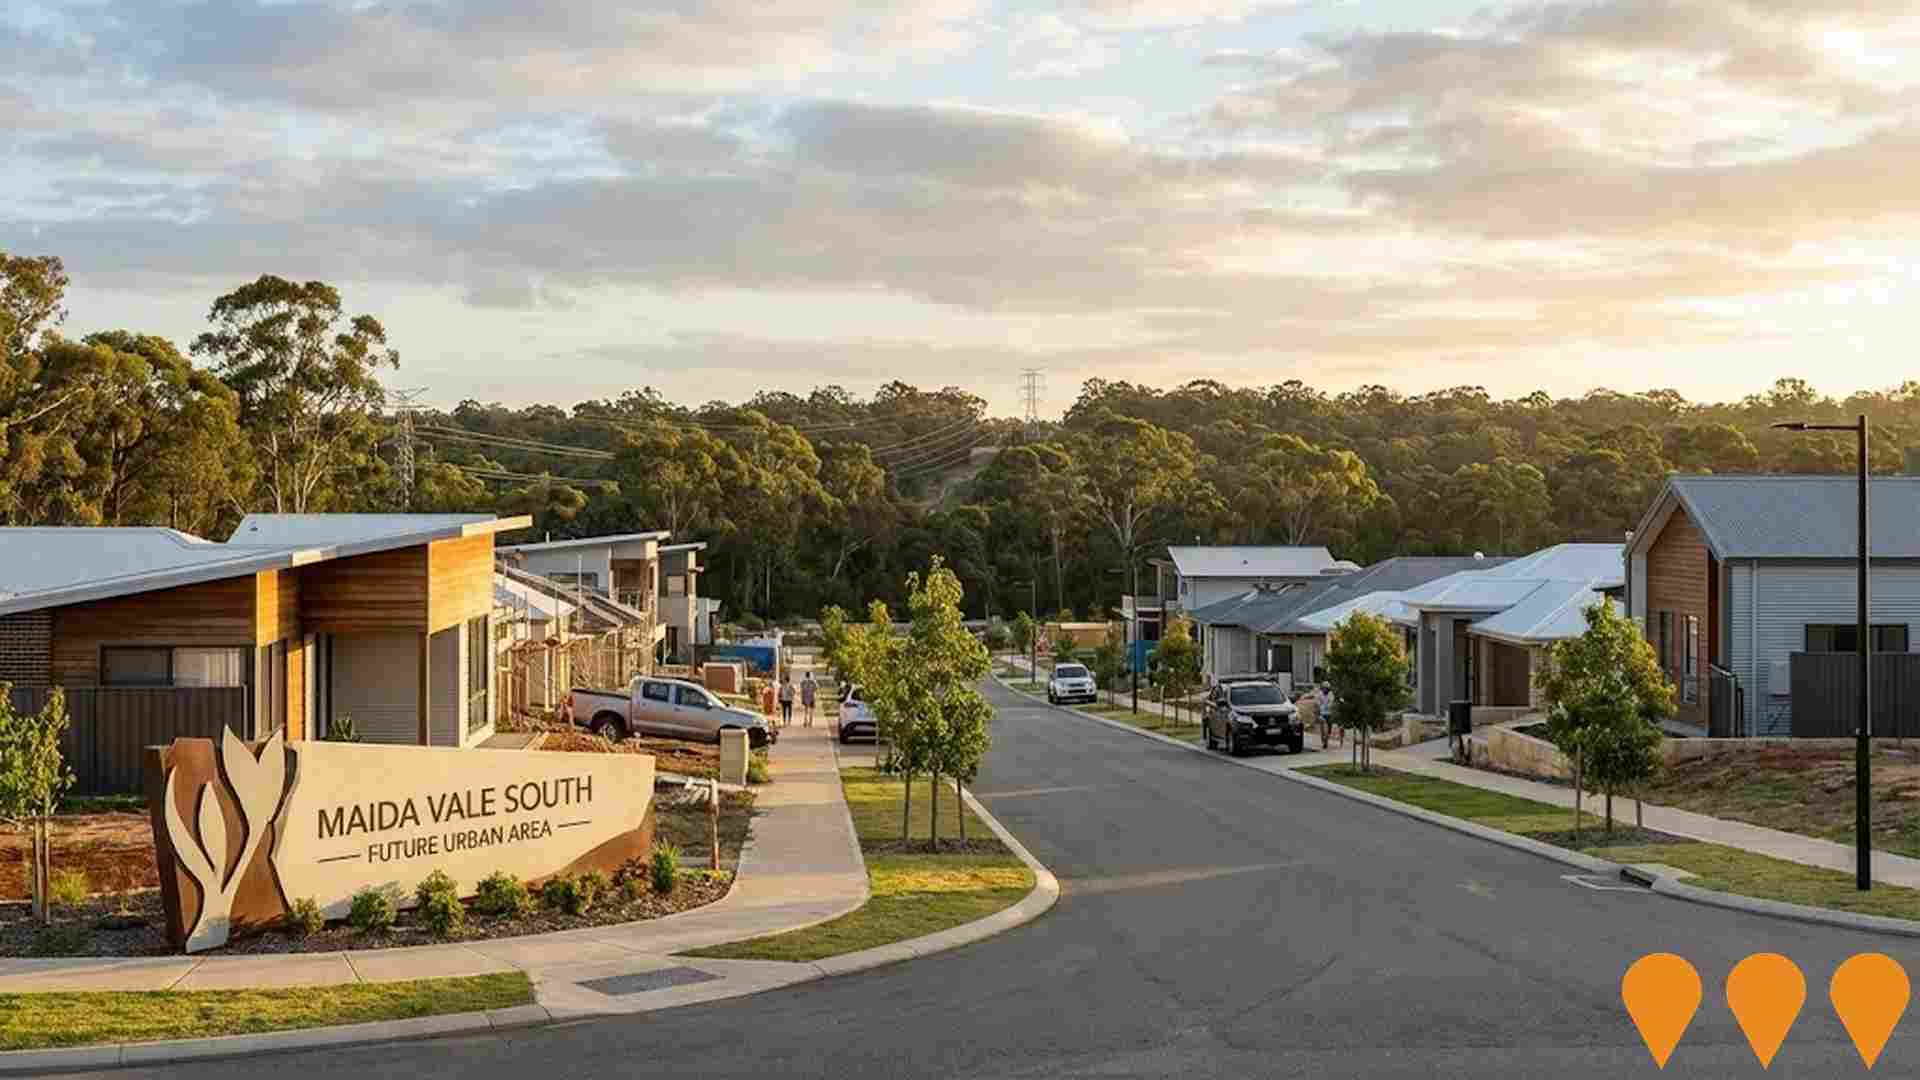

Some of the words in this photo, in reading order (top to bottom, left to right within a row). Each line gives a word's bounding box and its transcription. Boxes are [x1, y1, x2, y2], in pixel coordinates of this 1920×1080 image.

[317, 798, 420, 839] MAIDA
[427, 787, 496, 823] VALE
[504, 775, 592, 814] SOUTH
[368, 836, 439, 863] FUTURE
[443, 827, 504, 853] URBAN
[507, 819, 552, 843] AREA
